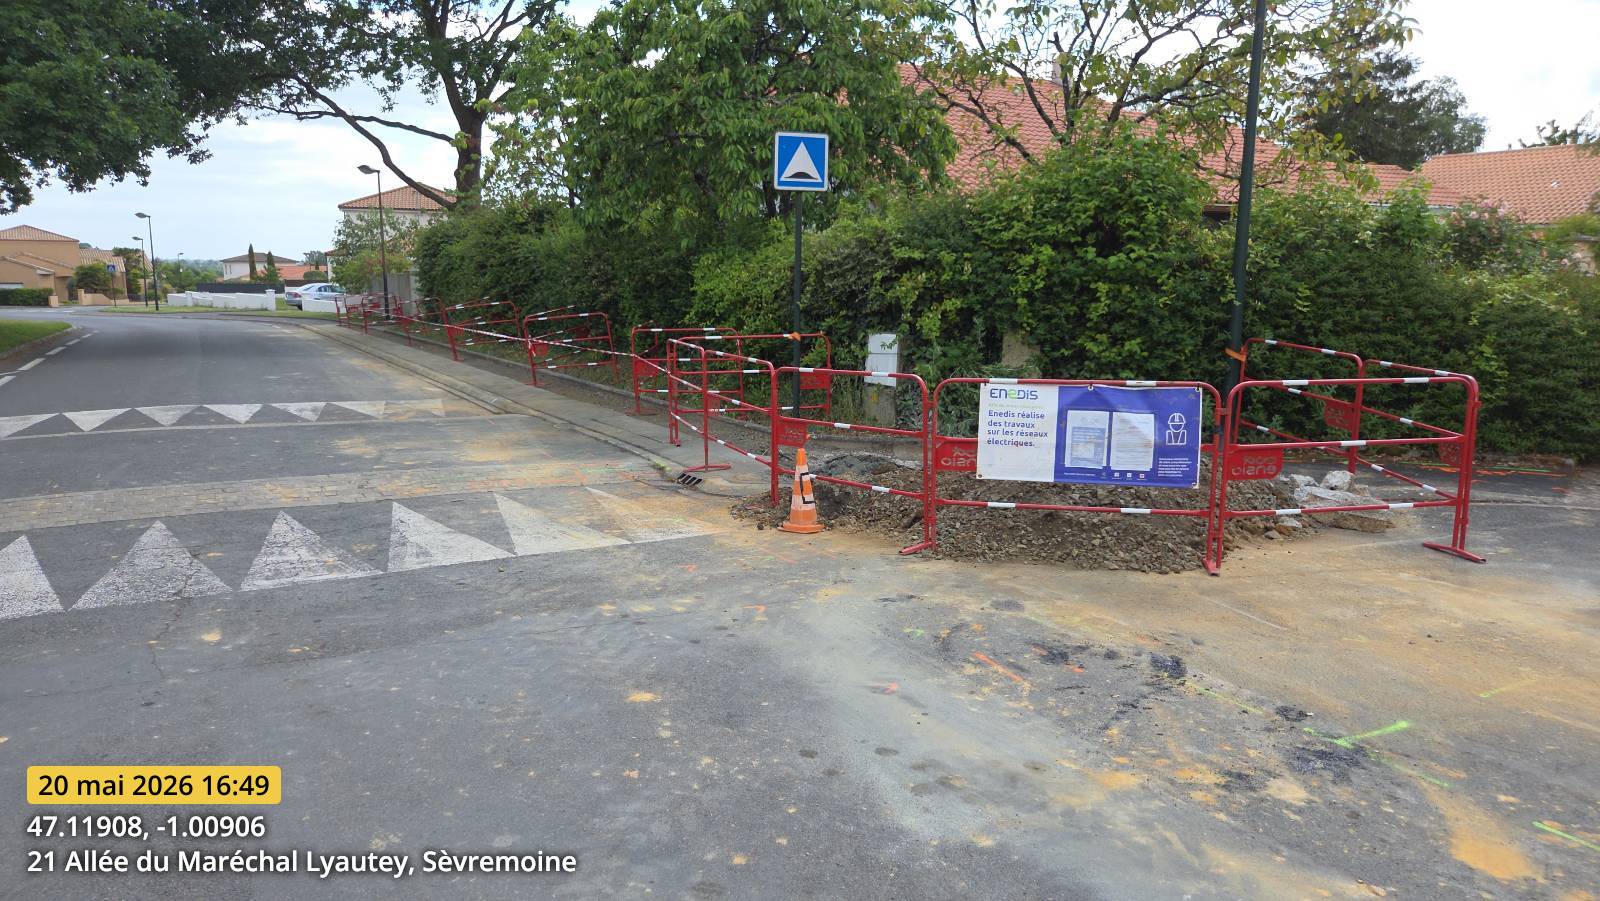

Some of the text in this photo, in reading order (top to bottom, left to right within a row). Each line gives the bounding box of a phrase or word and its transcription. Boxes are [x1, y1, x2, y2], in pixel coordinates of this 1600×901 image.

[988, 409, 1045, 419] Enedis réalise
[987, 419, 1035, 428] des travaux
[1002, 428, 1014, 436] les
[1016, 429, 1048, 437] réseaux
[987, 437, 1035, 447] électriques.
